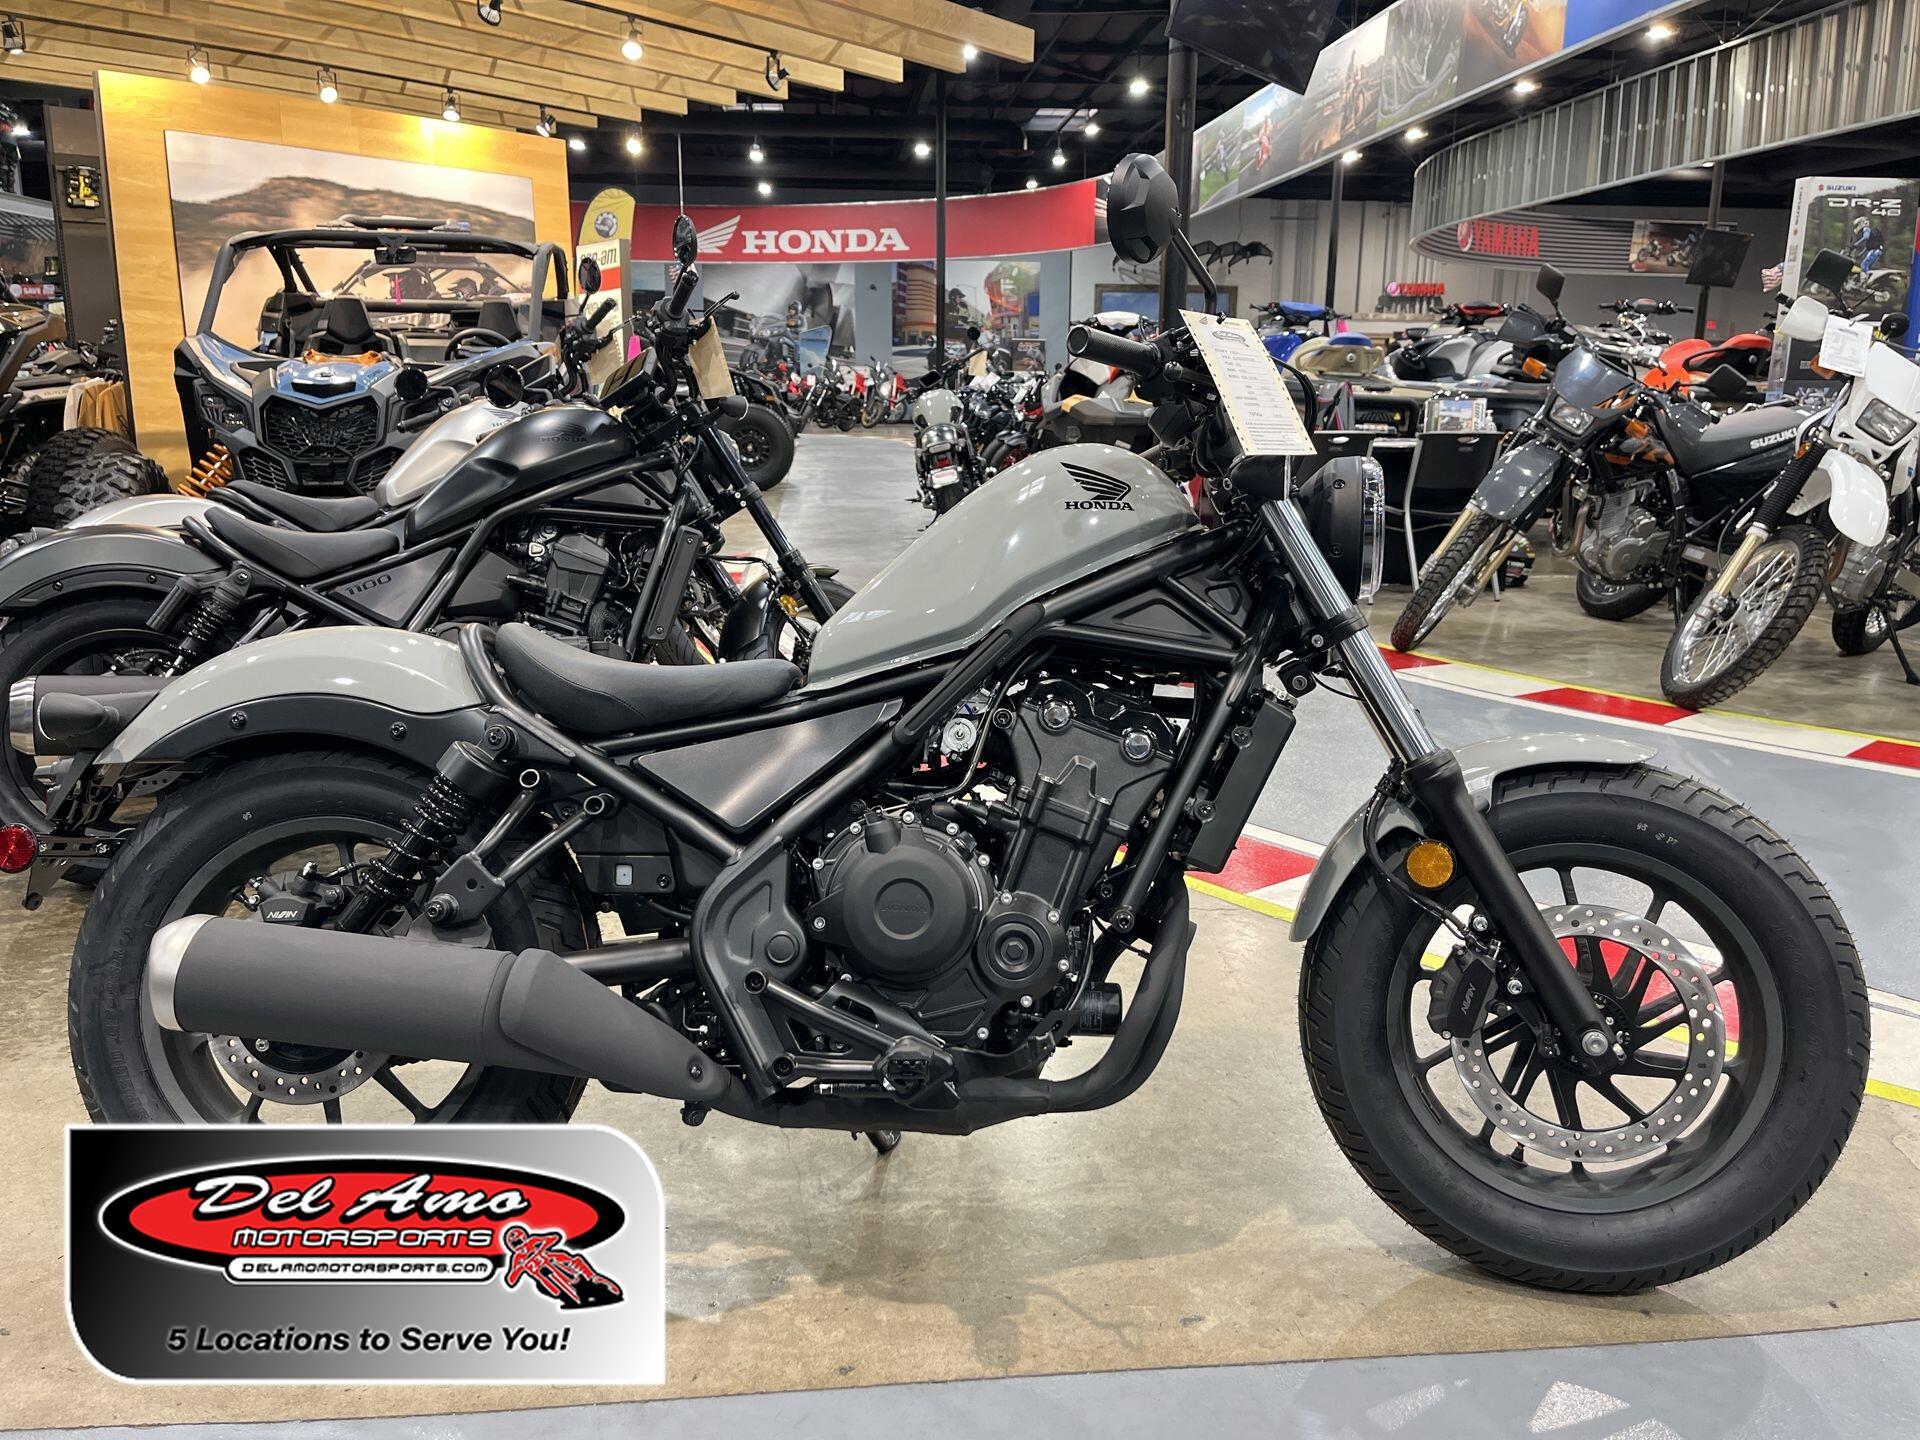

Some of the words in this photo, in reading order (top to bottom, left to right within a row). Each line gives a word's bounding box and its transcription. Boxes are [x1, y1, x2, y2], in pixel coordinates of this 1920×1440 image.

[1827, 197, 1902, 208] DR-Z
[741, 228, 910, 254] HONDA
[1471, 219, 1540, 258] YAMAHA
[1749, 427, 1798, 450] SUZUKI
[1064, 500, 1135, 512] HONDA
